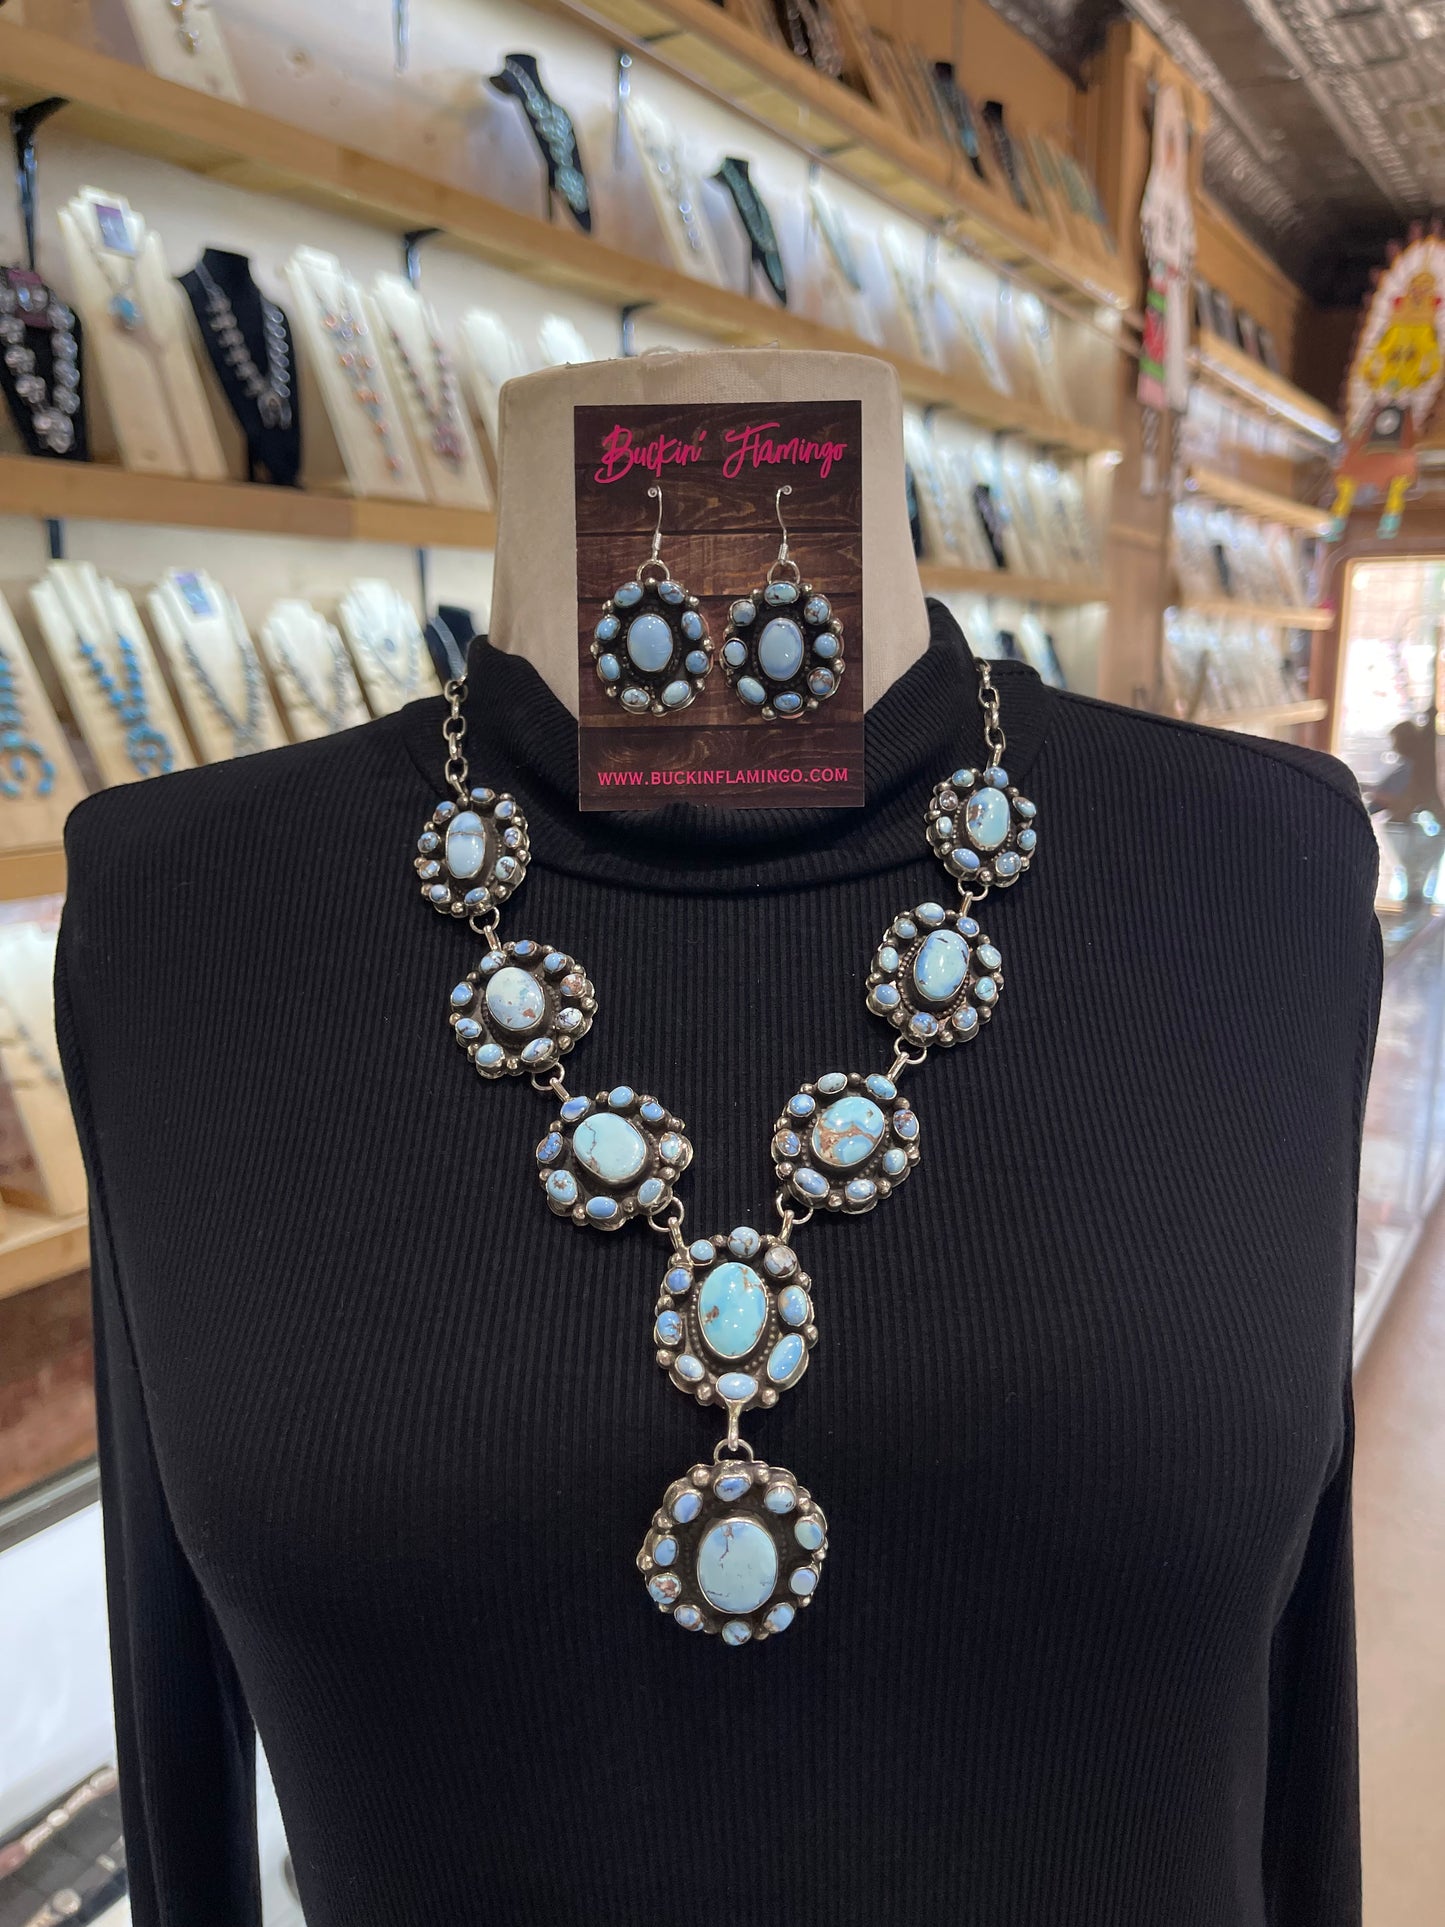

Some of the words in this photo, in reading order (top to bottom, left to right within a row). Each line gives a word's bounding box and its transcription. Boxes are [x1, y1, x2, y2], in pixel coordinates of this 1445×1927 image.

[594, 424, 708, 484] Buckin'
[722, 422, 848, 479] Flamingo
[597, 767, 849, 786] WWW.BUCKINFLAMINGO.COM
